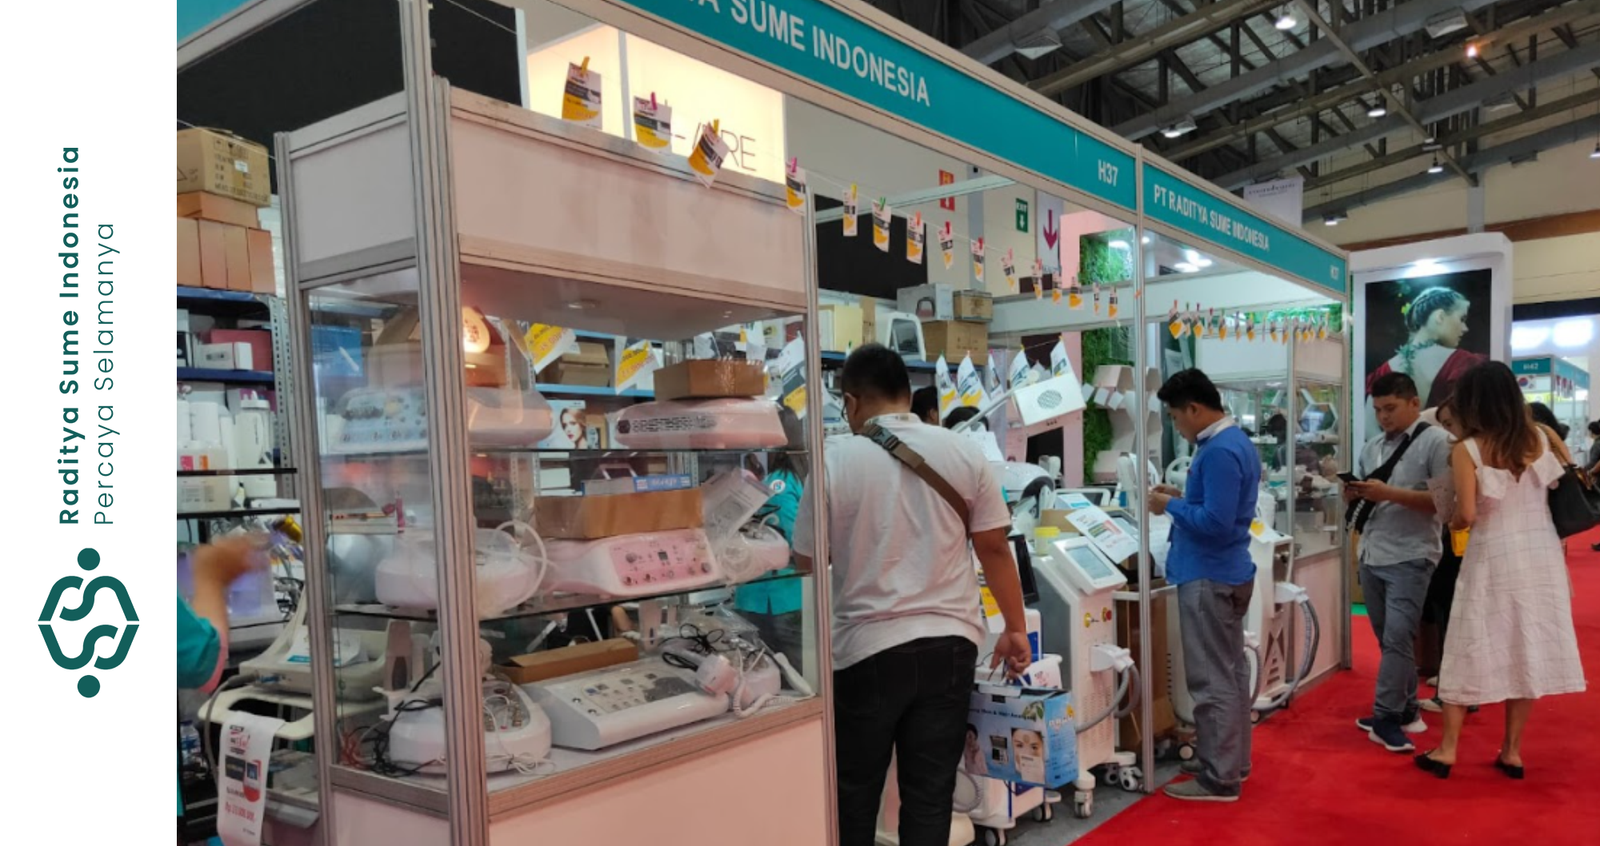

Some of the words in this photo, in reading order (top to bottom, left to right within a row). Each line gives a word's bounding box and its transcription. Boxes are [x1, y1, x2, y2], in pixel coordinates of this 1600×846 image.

[731, 0, 806, 51] SUME
[812, 25, 931, 107] INDONESIA
[1097, 159, 1119, 188] H37
[1016, 202, 1029, 214] EXIT
[1154, 184, 1167, 207] PT
[1169, 190, 1208, 225] RADITYA
[1209, 209, 1232, 236] SUME
[1231, 220, 1270, 252] INDONESIA
